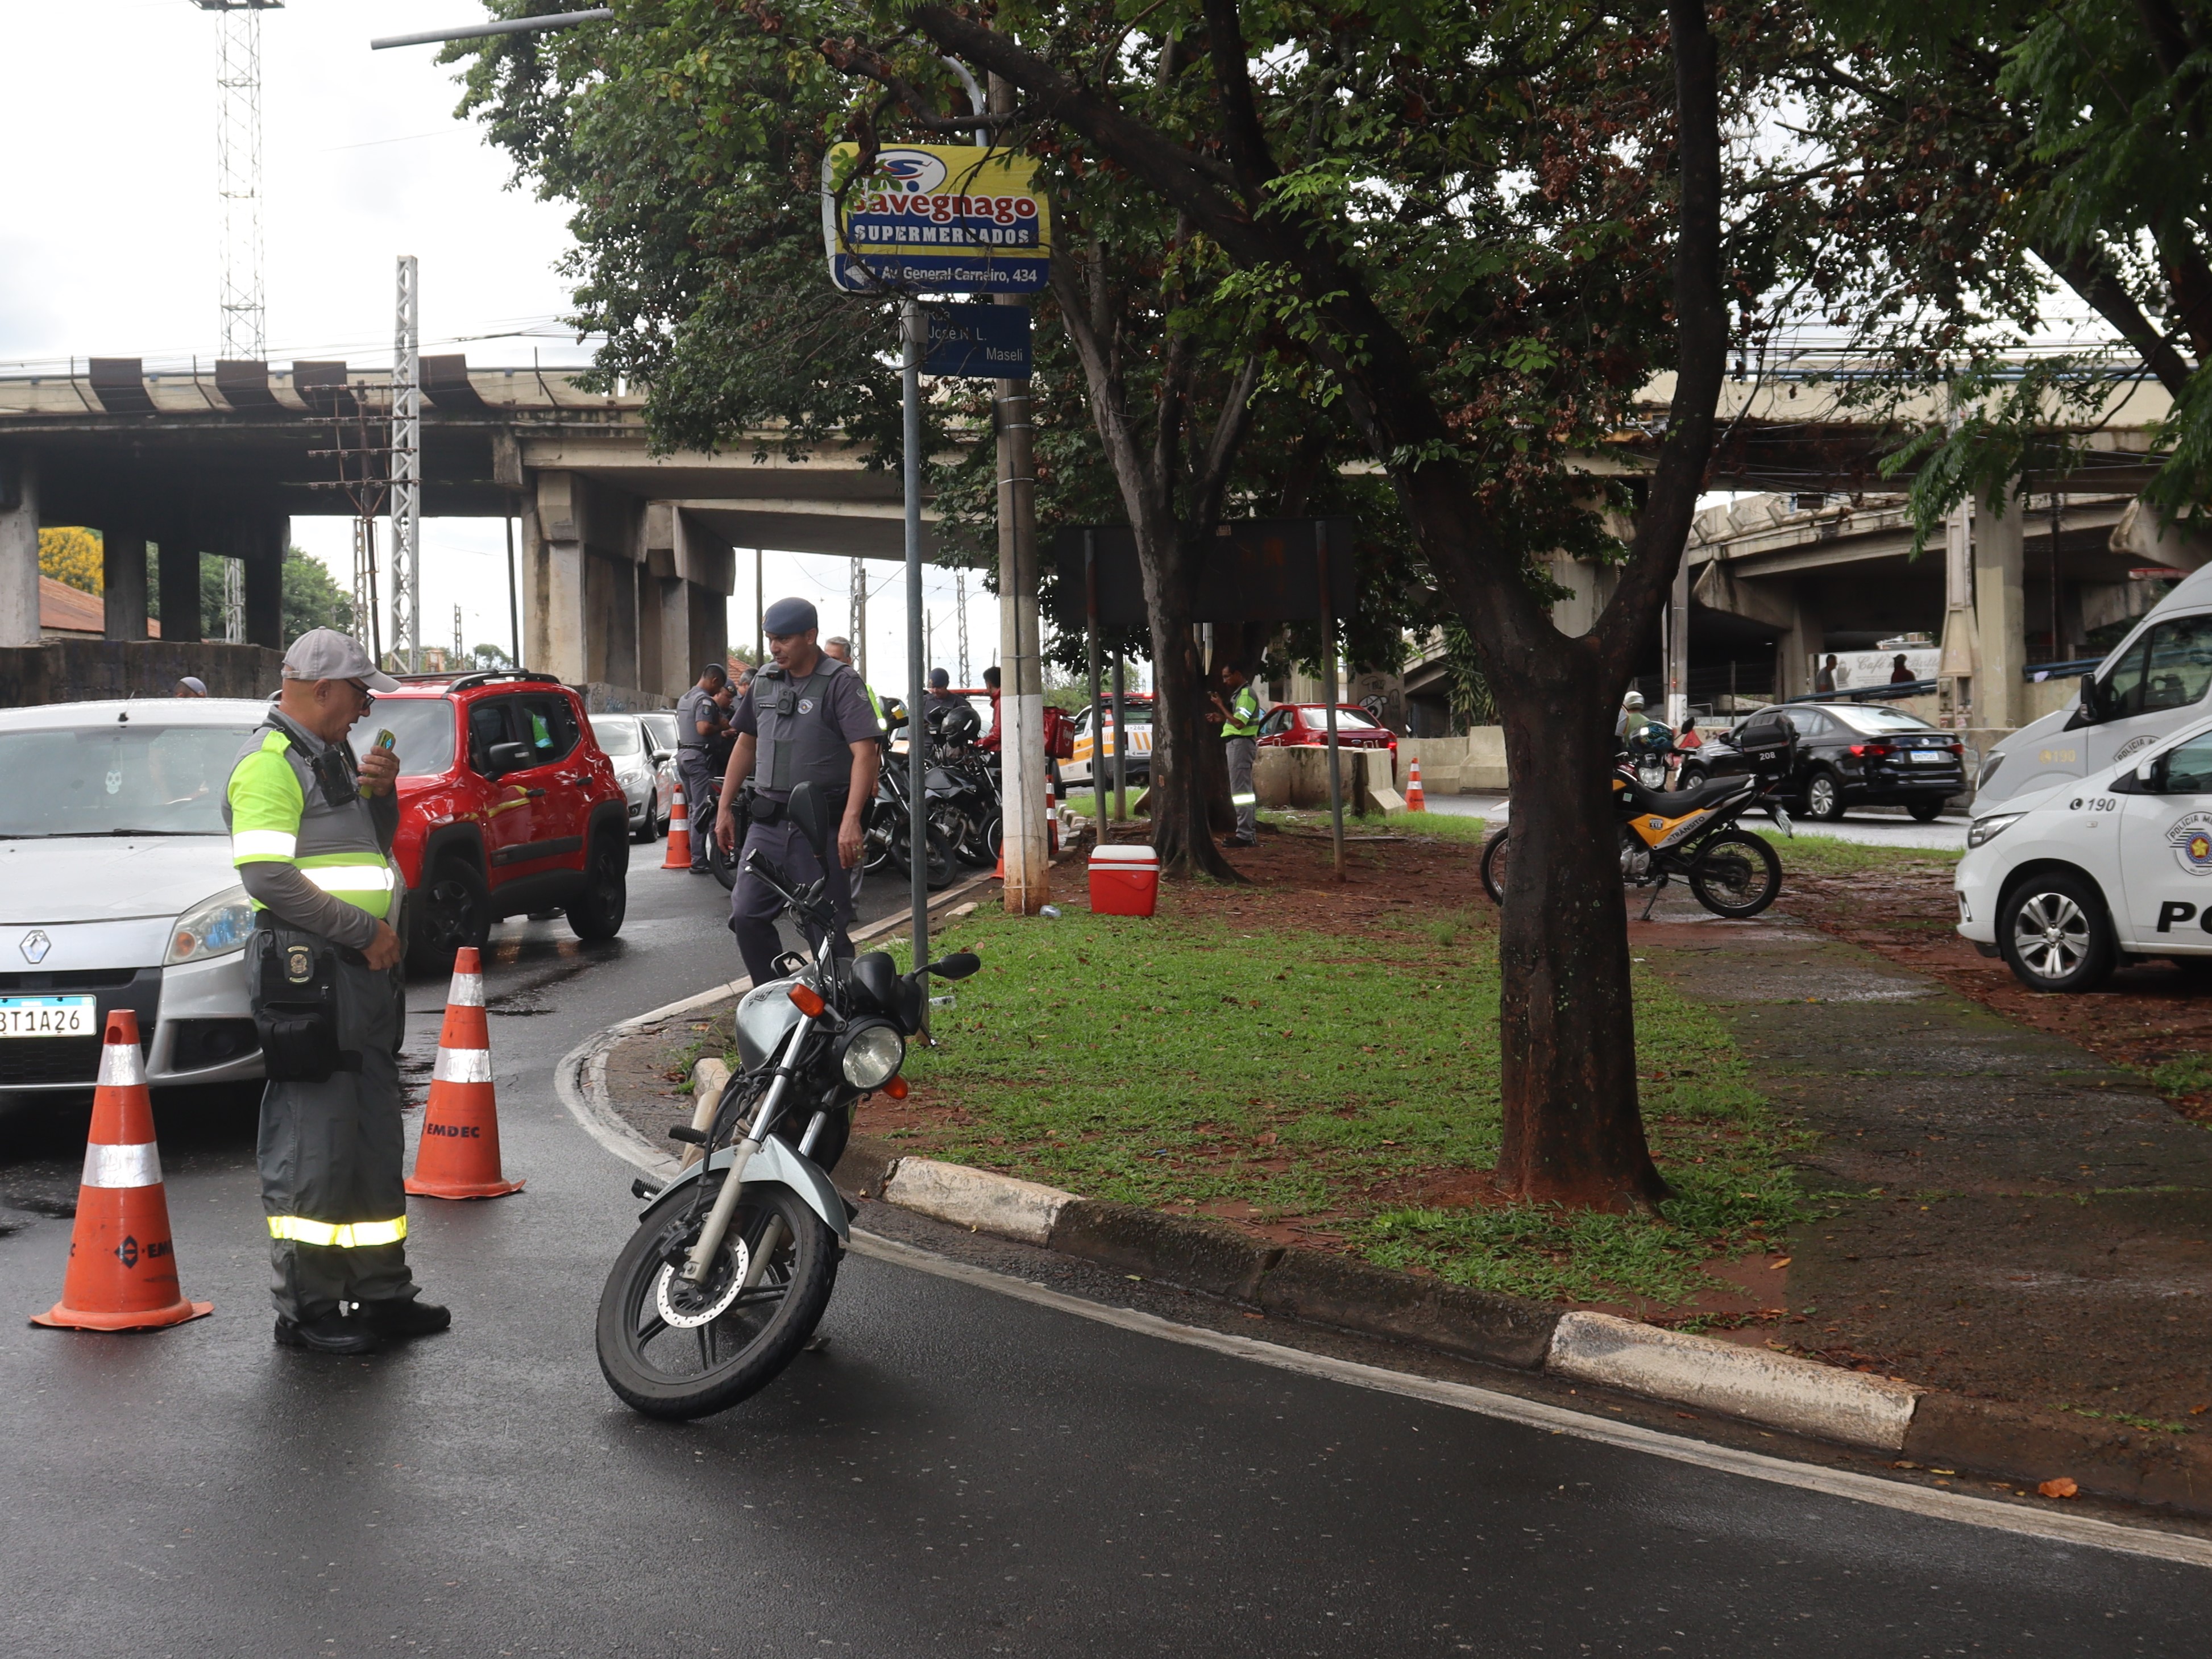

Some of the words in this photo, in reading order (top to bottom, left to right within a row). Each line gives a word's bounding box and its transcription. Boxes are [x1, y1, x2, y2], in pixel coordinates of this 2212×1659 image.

[854, 224, 1030, 244] SUPERMERCADOS
[903, 266, 951, 280] General
[954, 267, 1010, 284] Carneiro,
[1012, 269, 1037, 282] 434
[928, 325, 956, 339] José
[976, 327, 987, 341] L.
[986, 347, 1023, 361] Maseli
[1759, 751, 1776, 761] 208
[2052, 749, 2076, 763] 190
[2088, 798, 2116, 812] 190
[427, 1123, 479, 1138] EMDEC
